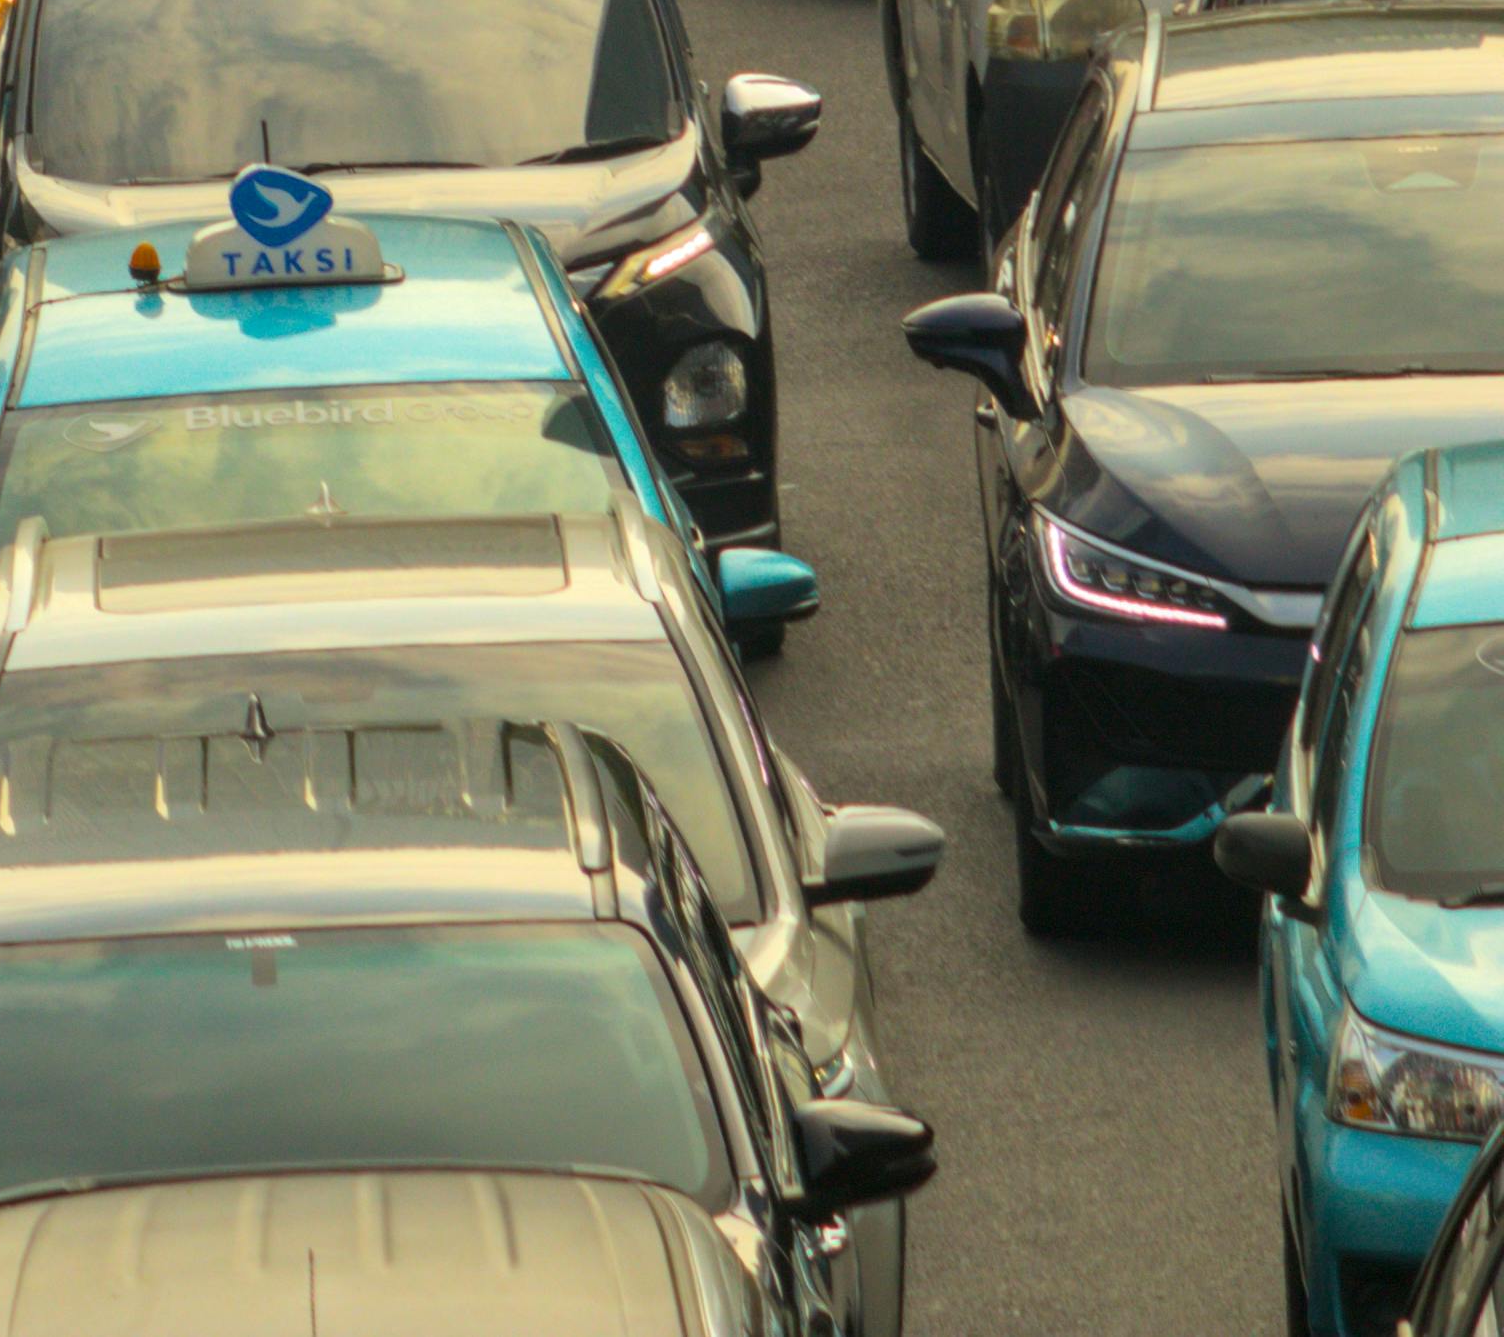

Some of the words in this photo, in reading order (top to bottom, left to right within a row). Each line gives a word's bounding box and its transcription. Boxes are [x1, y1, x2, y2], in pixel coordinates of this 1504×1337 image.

[221, 247, 353, 277] TAKSI
[183, 398, 395, 431] Bluebird
[408, 397, 534, 426] Group
